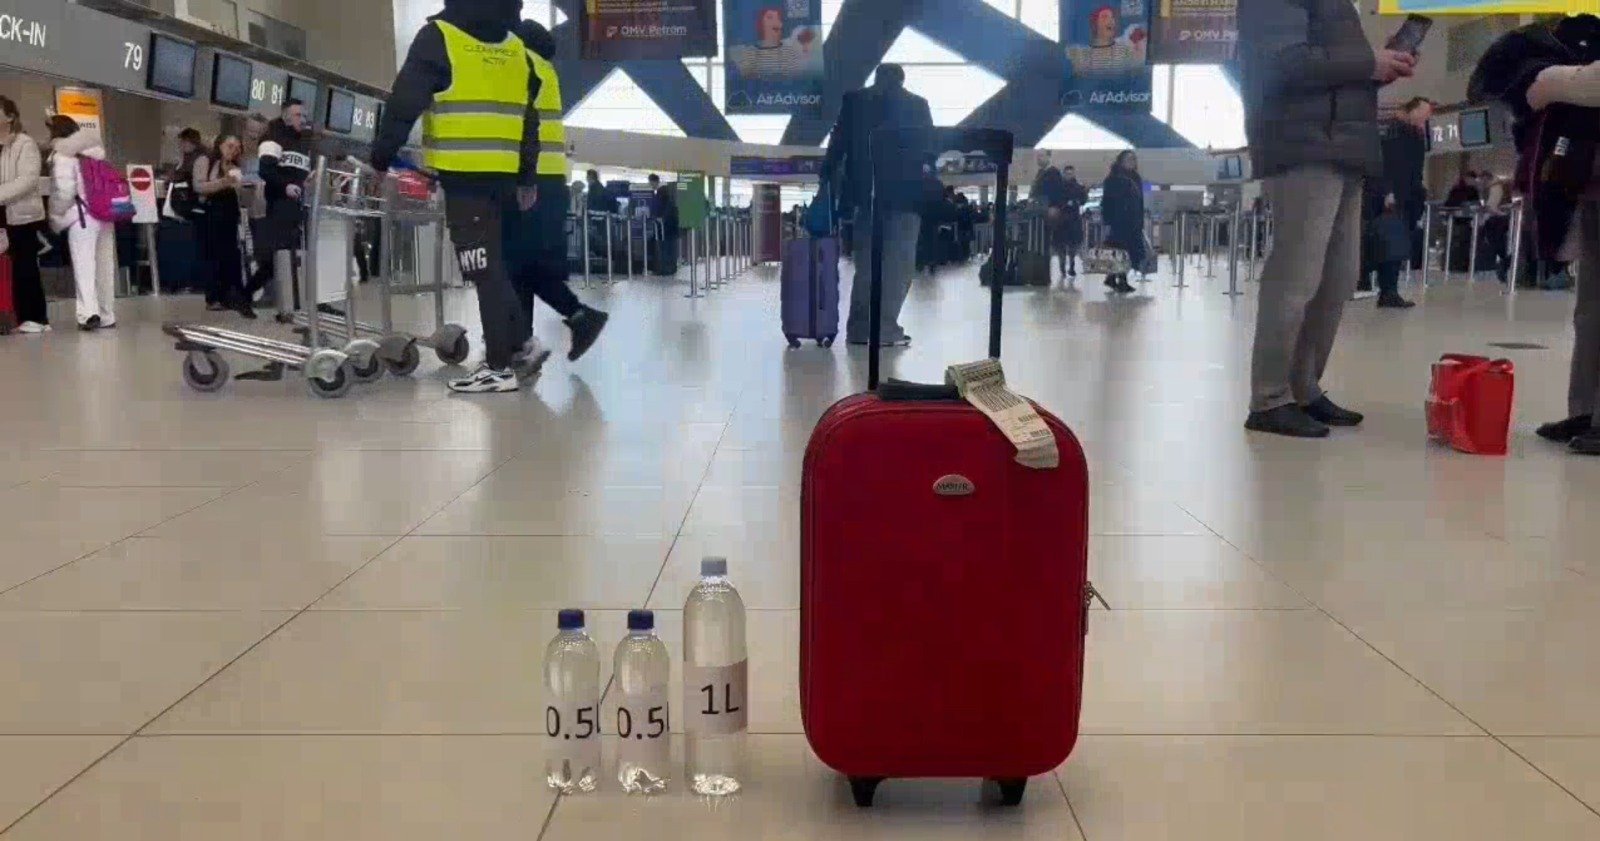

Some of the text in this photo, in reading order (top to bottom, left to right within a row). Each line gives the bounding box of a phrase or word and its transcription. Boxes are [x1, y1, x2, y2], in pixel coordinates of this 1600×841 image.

[620, 25, 645, 37] OMV
[124, 41, 143, 71] 79
[251, 78, 283, 106] 80 81
[756, 91, 823, 106] AirAdvisor
[1089, 90, 1150, 104] AirAdvisor
[459, 246, 488, 272] NYG
[701, 682, 740, 715] 1L
